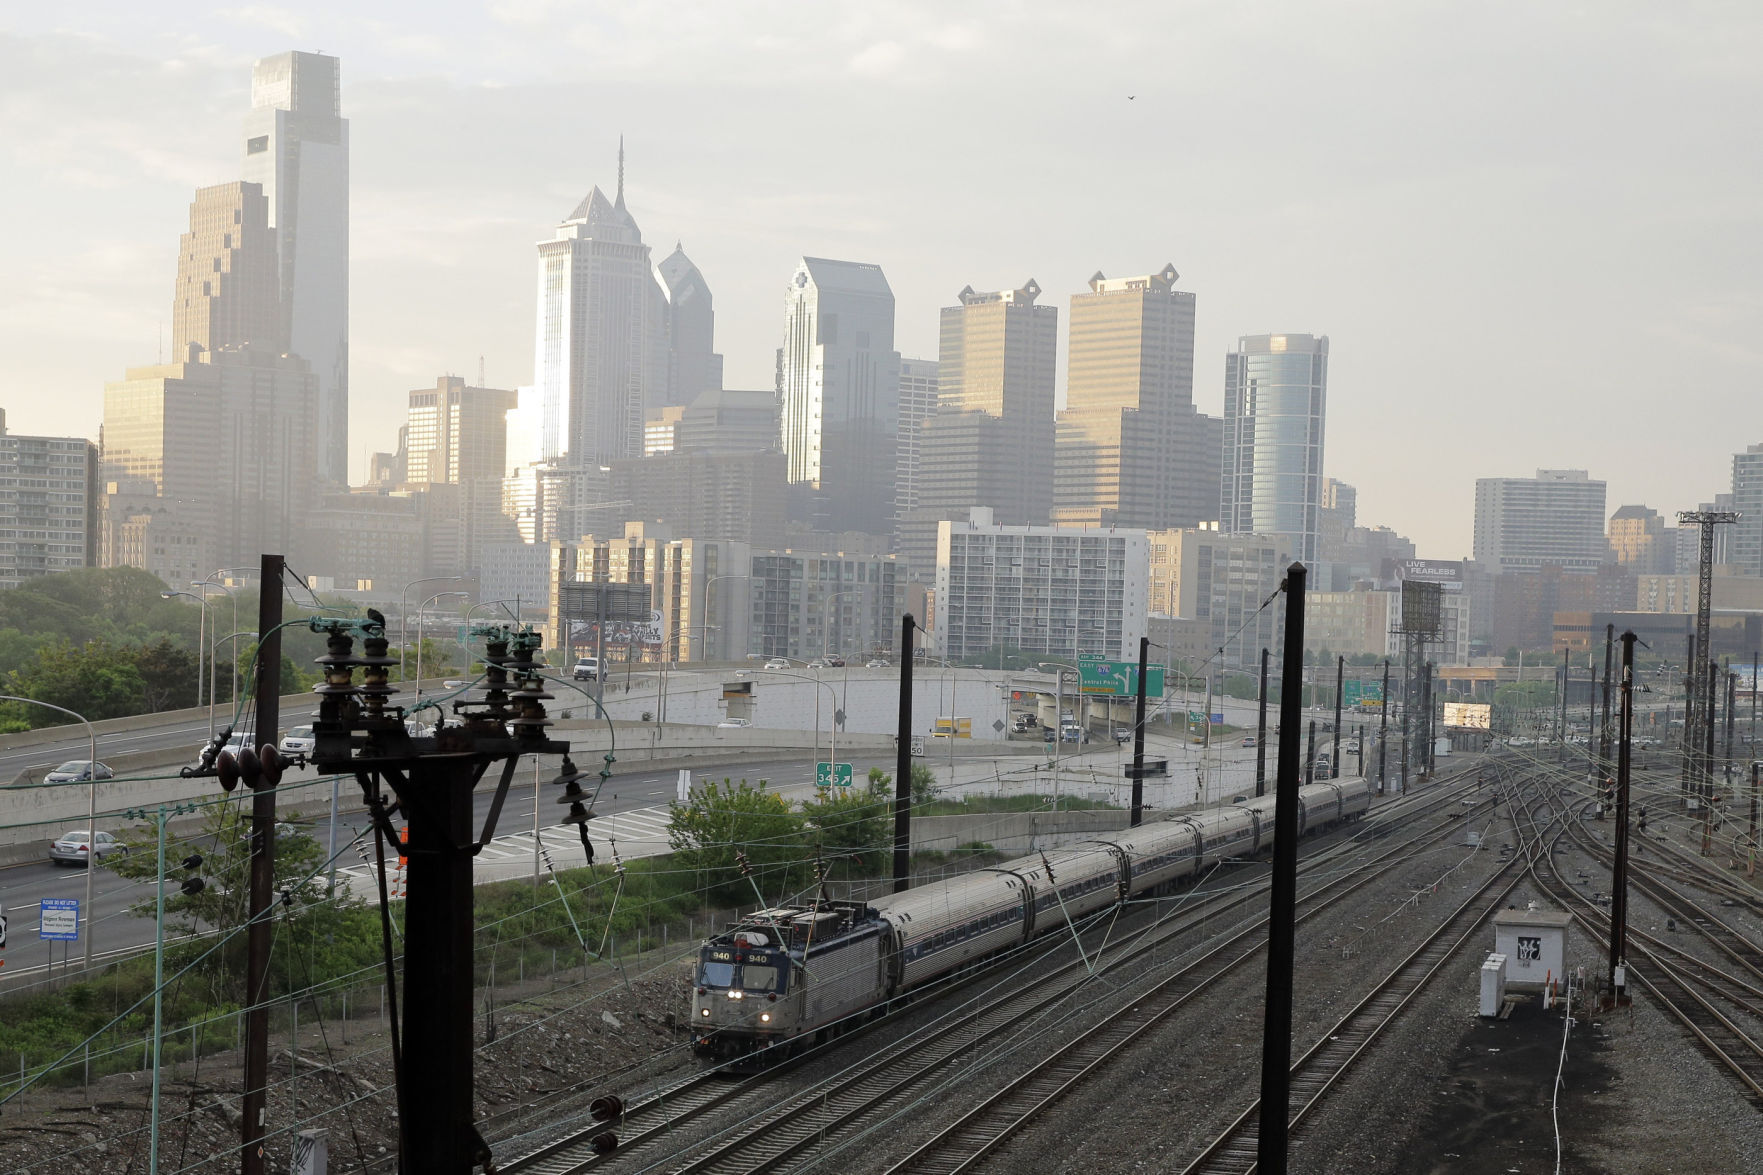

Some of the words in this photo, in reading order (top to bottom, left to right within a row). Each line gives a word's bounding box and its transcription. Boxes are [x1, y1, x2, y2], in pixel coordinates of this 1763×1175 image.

[1411, 567, 1456, 575] FEARLESS
[818, 774, 839, 782] 345
[713, 952, 729, 960] 940
